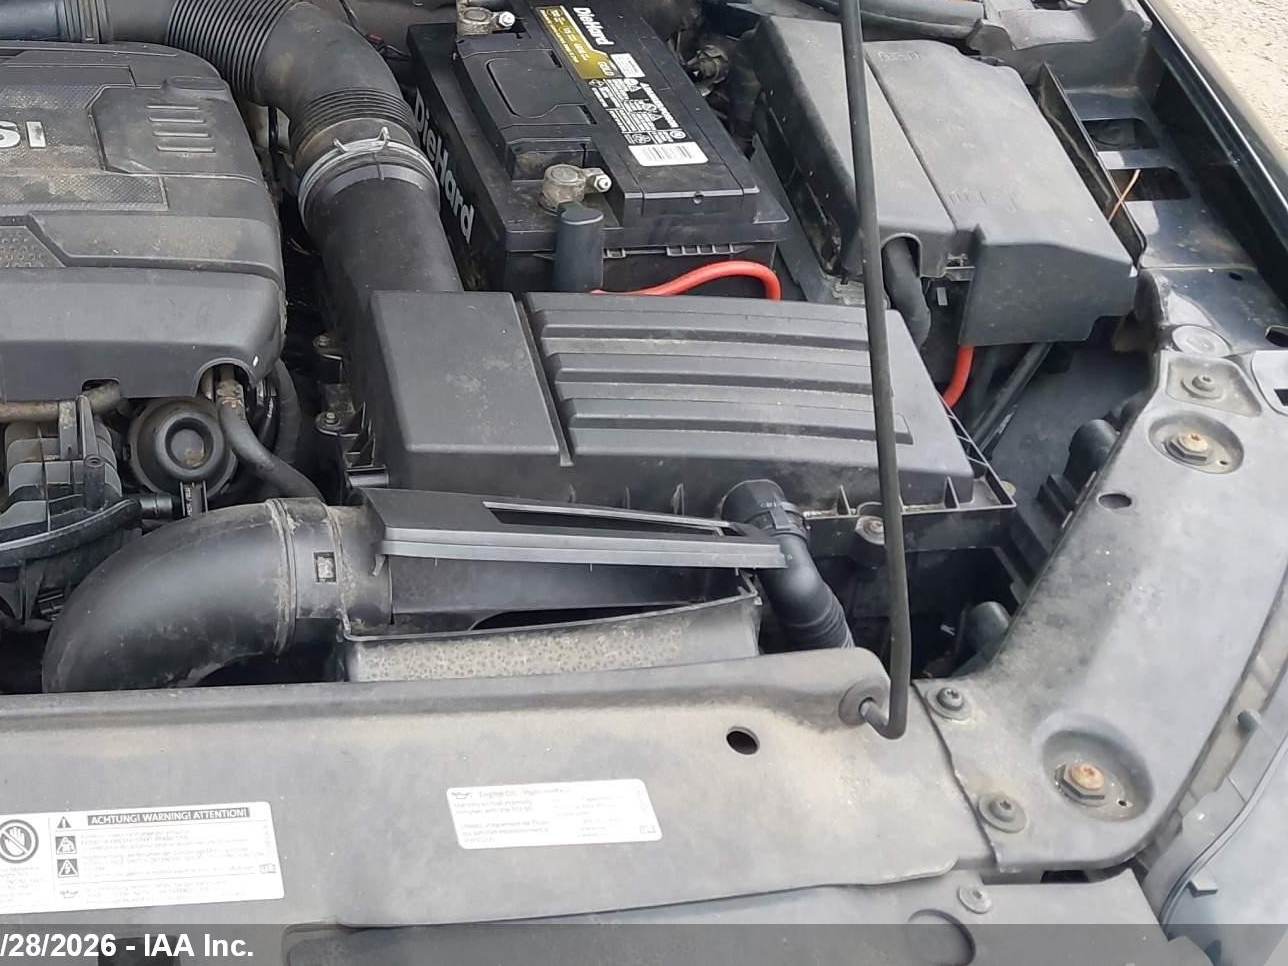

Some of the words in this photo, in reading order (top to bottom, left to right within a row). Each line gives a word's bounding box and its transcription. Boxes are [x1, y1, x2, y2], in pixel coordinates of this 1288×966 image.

[573, 7, 615, 46] DieHard
[414, 87, 475, 244] DieHard
[91, 814, 141, 825] ACHTUNG!
[142, 811, 192, 822] WARNING!
[193, 808, 247, 820] ATTENTION!
